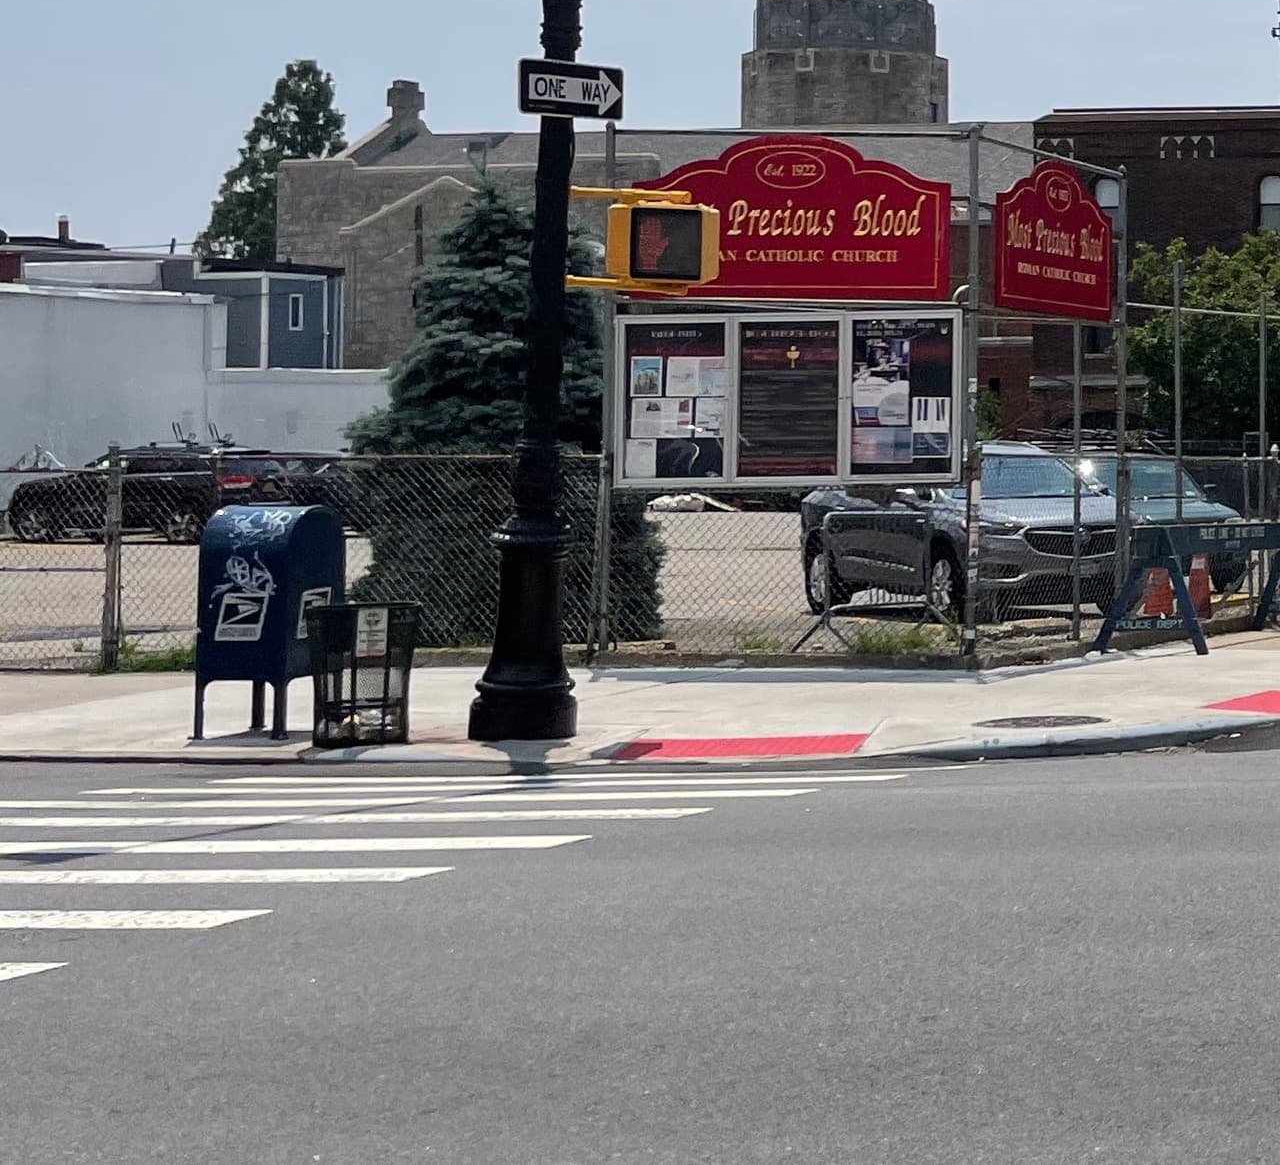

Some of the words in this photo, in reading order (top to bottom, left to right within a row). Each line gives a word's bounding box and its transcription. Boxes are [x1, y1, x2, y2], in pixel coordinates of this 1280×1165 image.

[534, 77, 567, 98] ONE
[581, 81, 611, 103] WAY
[727, 199, 836, 236] Precious
[853, 194, 926, 236] Blood
[746, 249, 824, 262] CATHOLIC
[832, 249, 898, 262] CHURCH
